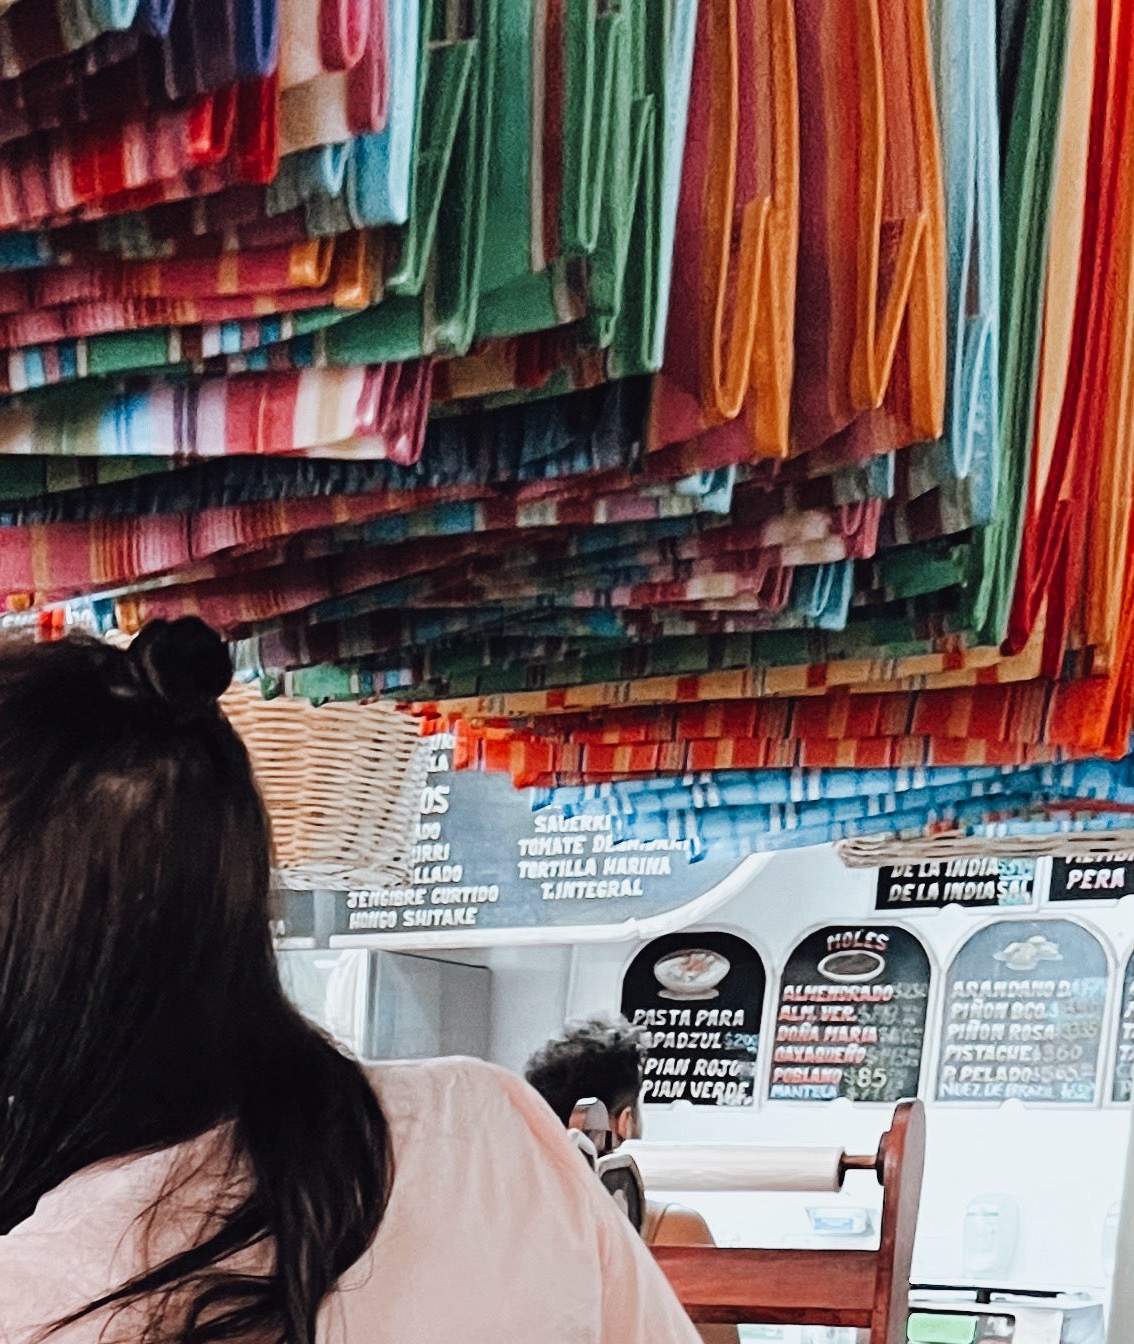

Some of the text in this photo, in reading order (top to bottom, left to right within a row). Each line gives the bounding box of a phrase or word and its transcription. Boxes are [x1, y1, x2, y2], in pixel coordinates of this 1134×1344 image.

[517, 835, 585, 857] TOMATE
[414, 865, 463, 884] LLADO
[517, 855, 671, 879] TORTILLA HARINA
[1066, 868, 1126, 890] PERA
[347, 885, 500, 909] JENGIBRE CURTIDO
[888, 884, 915, 902] DE
[917, 882, 940, 901] LA
[944, 881, 995, 901] INDIA
[348, 909, 397, 930] HONGO
[827, 931, 890, 951] MOLES
[783, 984, 894, 1002] ALMENDRADO
[633, 1008, 745, 1027] PASTA PARA
[639, 1031, 722, 1049] APADZUL
[1009, 1023, 1054, 1041] ROSA
